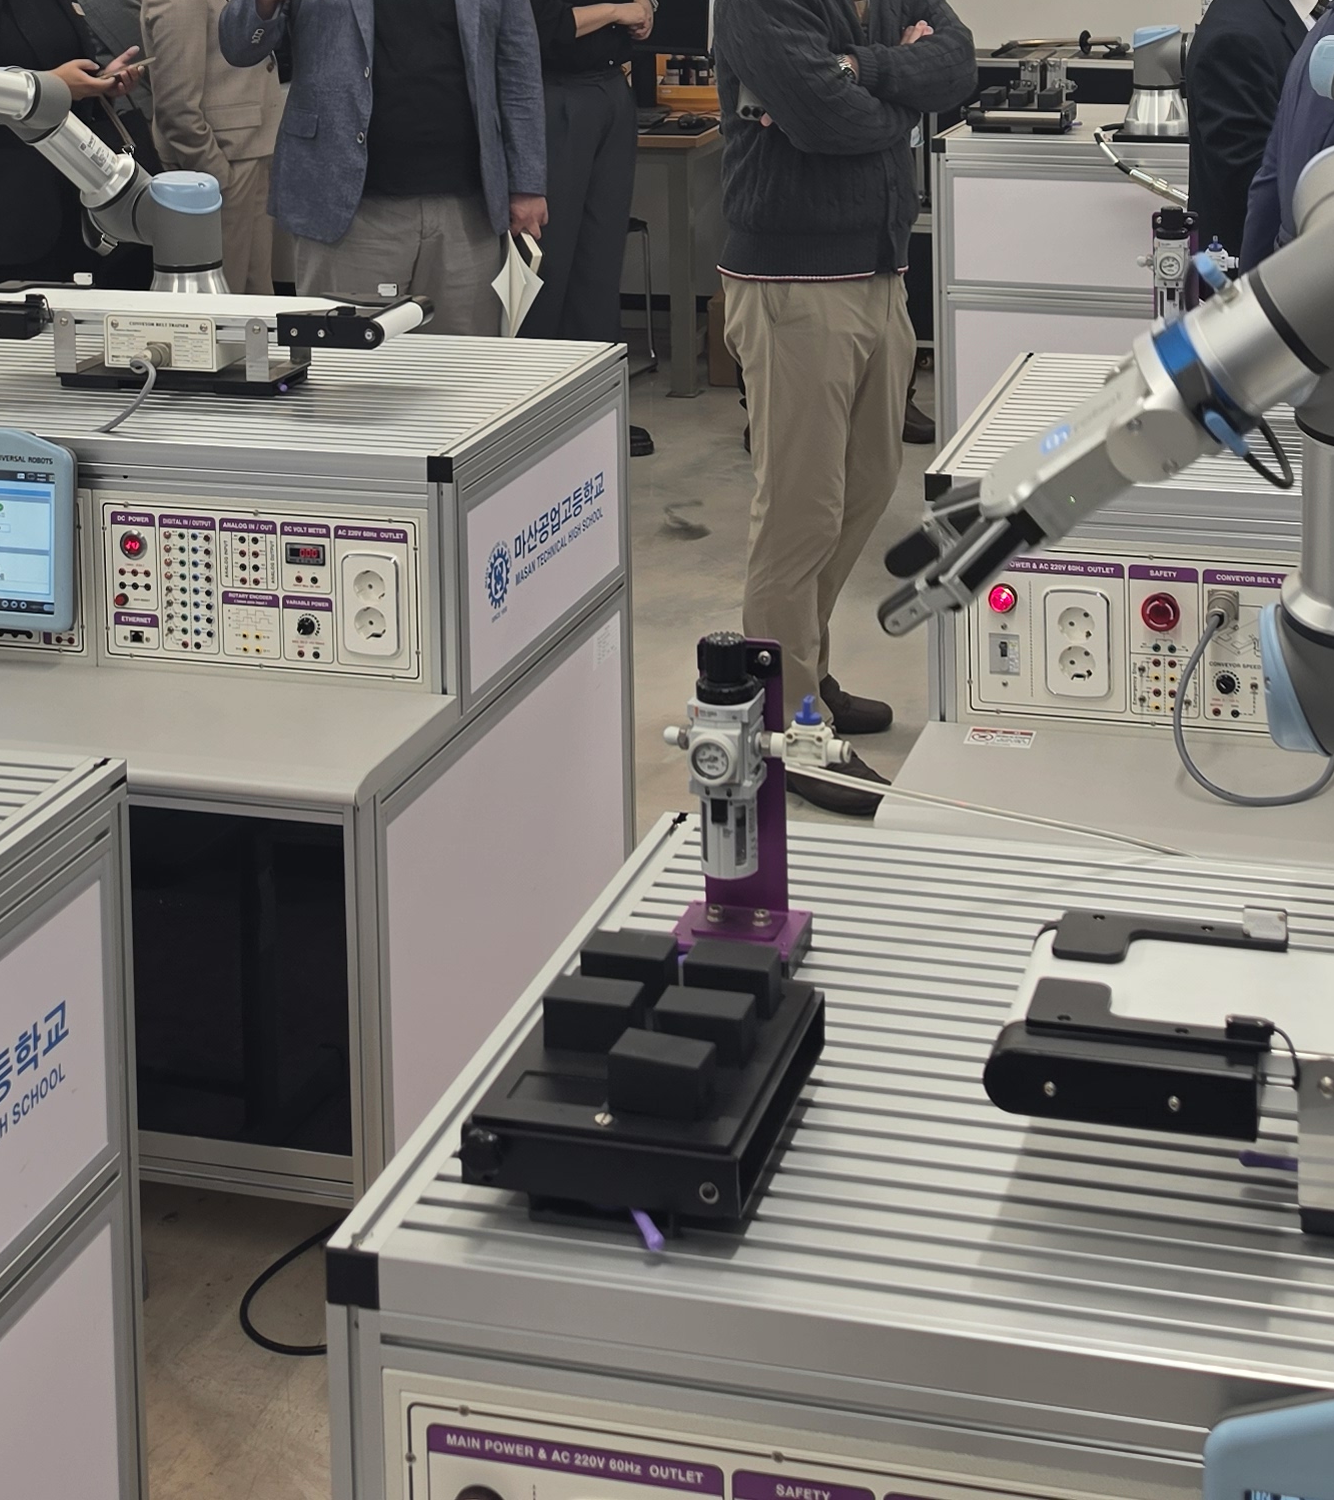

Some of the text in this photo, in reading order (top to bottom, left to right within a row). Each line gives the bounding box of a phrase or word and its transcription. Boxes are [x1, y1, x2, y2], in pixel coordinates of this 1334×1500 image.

[28, 456, 53, 465] ROBOTS
[515, 471, 605, 559] 마산공업고등학교
[1009, 561, 1030, 569] OWER
[1088, 566, 1114, 574] OUTLET
[1150, 570, 1177, 578] SAFETY
[1216, 574, 1255, 583] CONVEYOR
[1256, 575, 1275, 583] BELT
[121, 616, 151, 624] ETHERNET
[12, 1063, 66, 1125] SCHOOL
[446, 1433, 704, 1485] MAIN POWER & AC 220V 60Hz OUTLET
[775, 1482, 831, 1500] SAFETY
